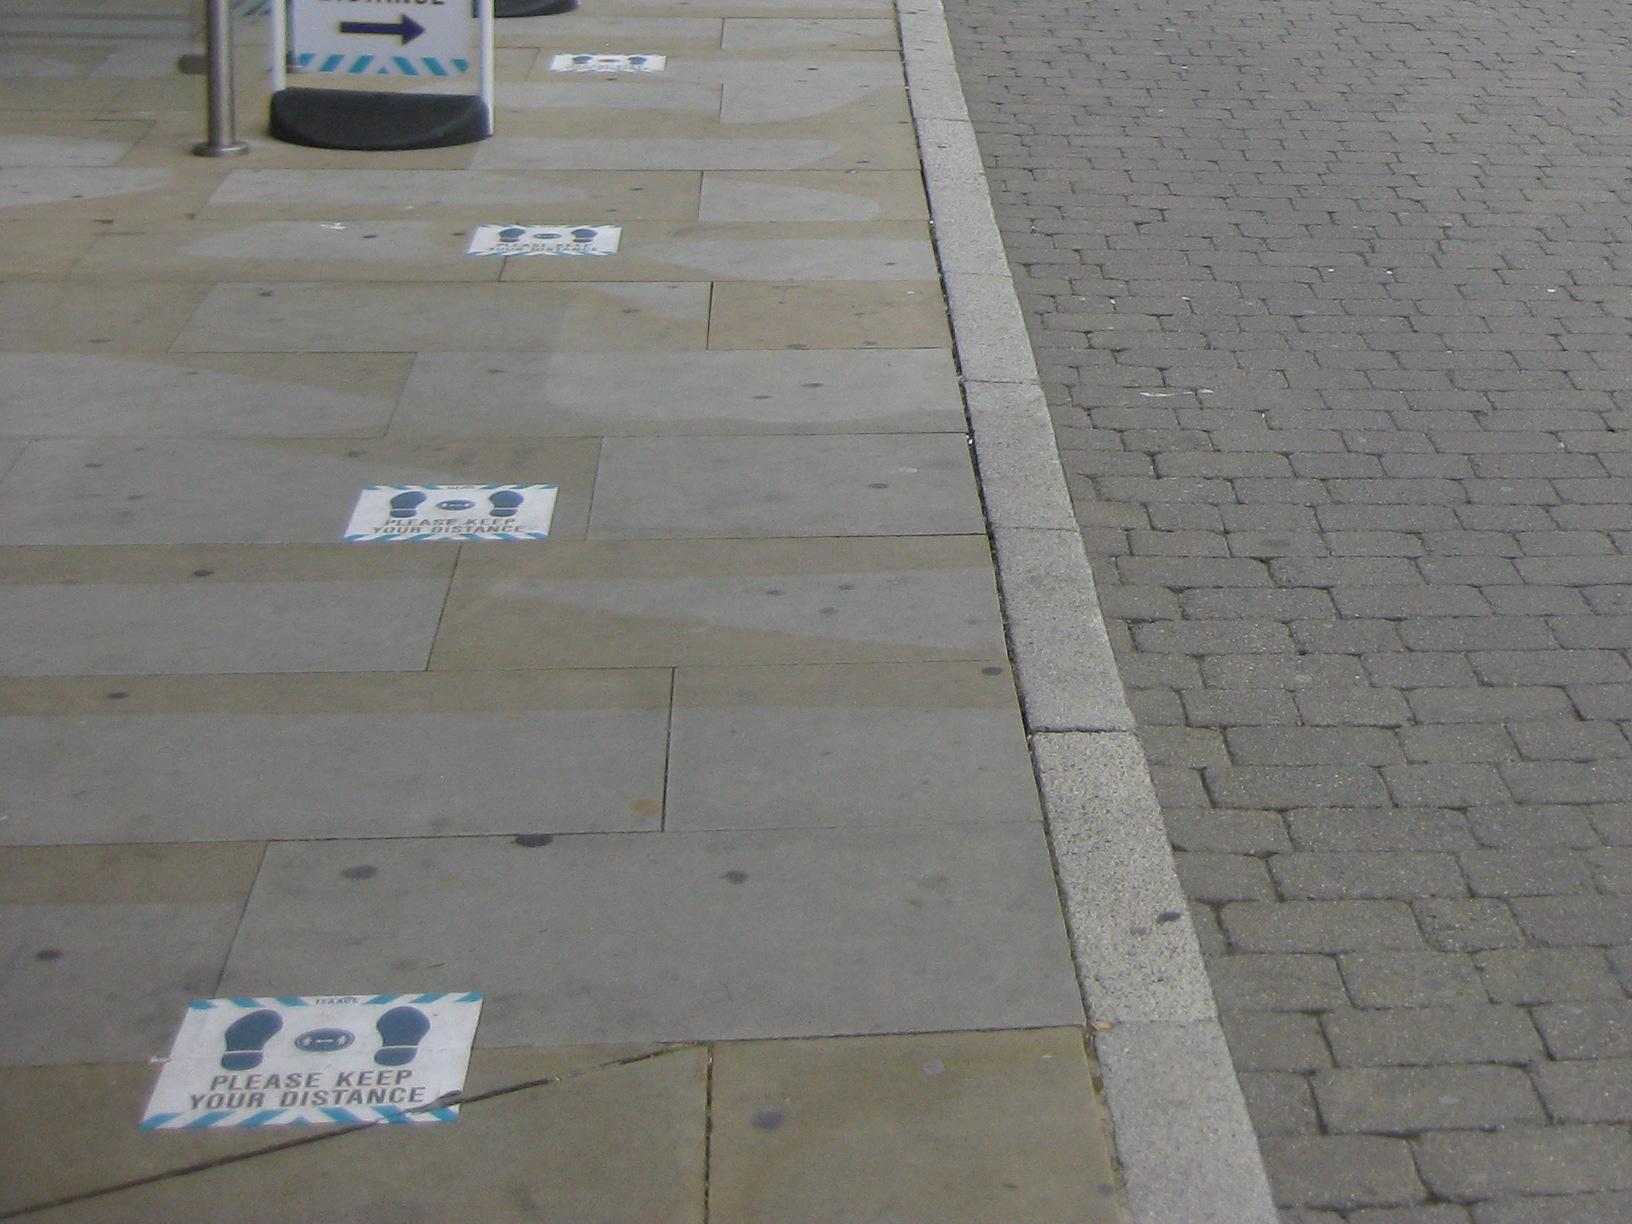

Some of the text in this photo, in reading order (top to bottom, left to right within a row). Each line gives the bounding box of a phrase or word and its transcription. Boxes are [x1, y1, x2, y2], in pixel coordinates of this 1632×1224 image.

[372, 525, 525, 534] YOUR DISTANCE
[384, 517, 516, 527] PLEASE KEEP
[210, 1068, 414, 1091] PLEASE KEEP
[190, 1087, 427, 1111] YOUR DISTANCE
